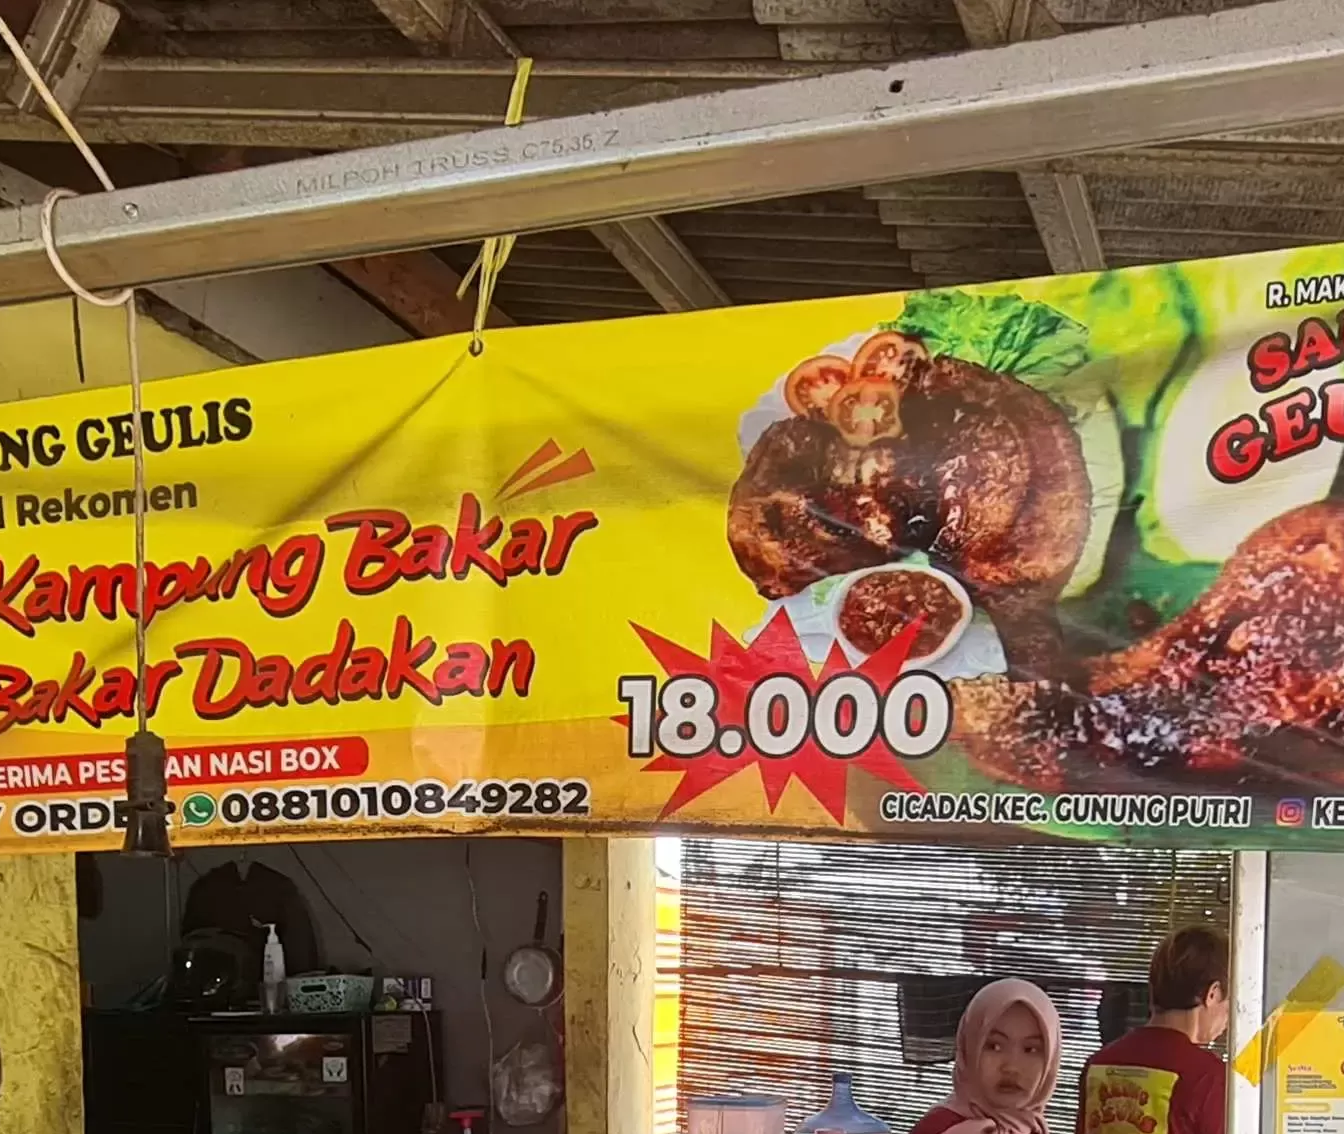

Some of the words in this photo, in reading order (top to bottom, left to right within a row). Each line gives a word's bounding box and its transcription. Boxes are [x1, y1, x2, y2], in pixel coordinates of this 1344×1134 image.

[1267, 281, 1289, 308] R.
[76, 398, 254, 462] GEULIS
[16, 480, 198, 528] Rekomen
[326, 491, 599, 596] Bakar
[175, 616, 536, 723] Dadakan
[619, 669, 954, 760] 18.000
[78, 752, 202, 785] PESAN
[209, 749, 272, 777] NASI
[280, 744, 341, 773] BOX
[12, 797, 176, 836] ORD
[219, 782, 590, 826] 0881010849282
[880, 792, 989, 824] CICADAS
[990, 793, 1049, 824] KEC.
[1053, 794, 1171, 827] GUNUNG
[1170, 795, 1253, 828] PUTRI
